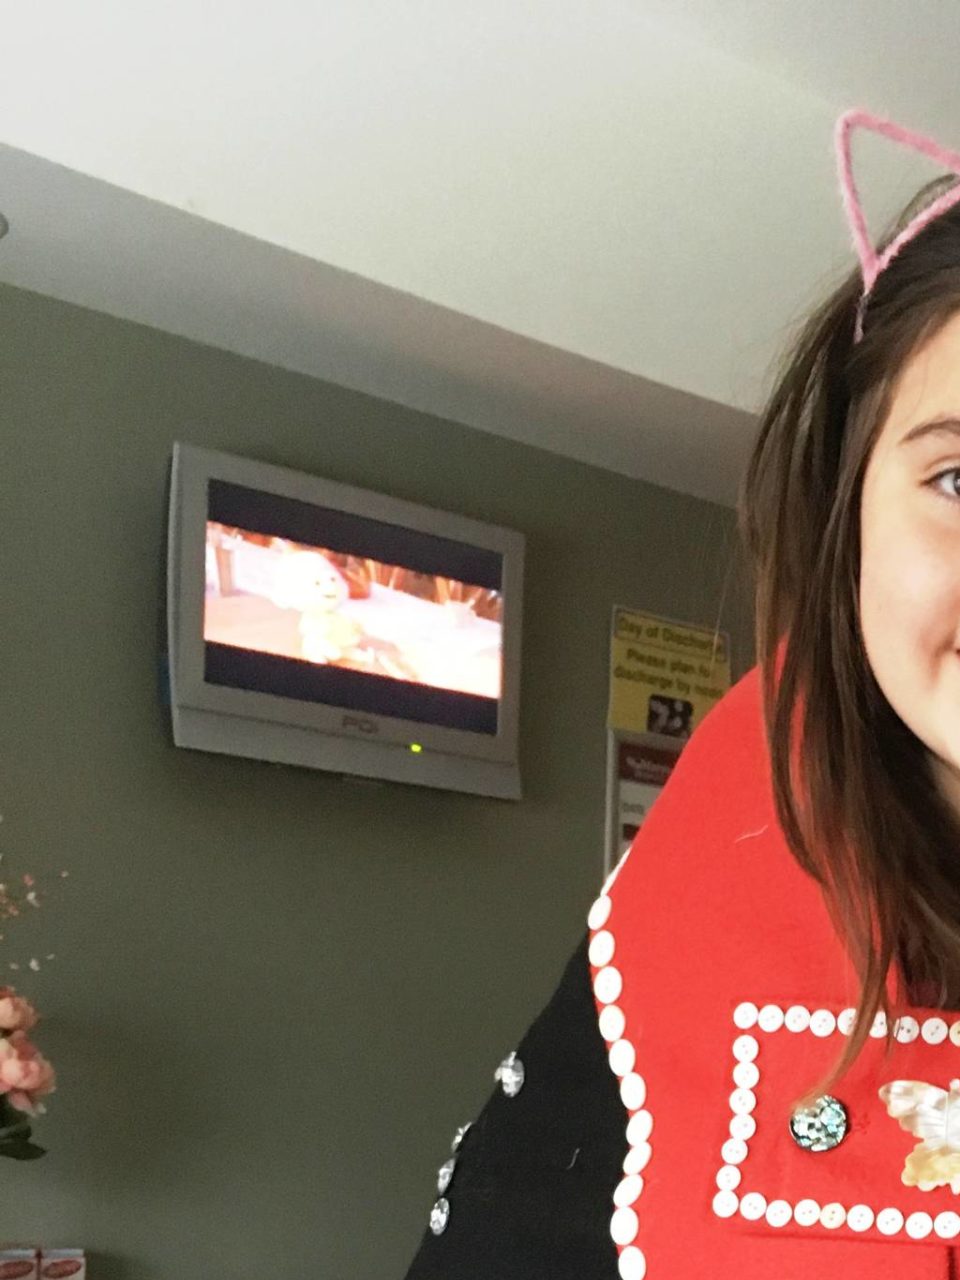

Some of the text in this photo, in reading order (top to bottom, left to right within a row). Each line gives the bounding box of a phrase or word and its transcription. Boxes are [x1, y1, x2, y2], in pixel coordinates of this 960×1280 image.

[617, 616, 642, 638] Day
[645, 626, 658, 638] of
[627, 648, 666, 668] Please
[670, 660, 696, 675] plan
[614, 665, 673, 689] discharge
[676, 678, 691, 695] by
